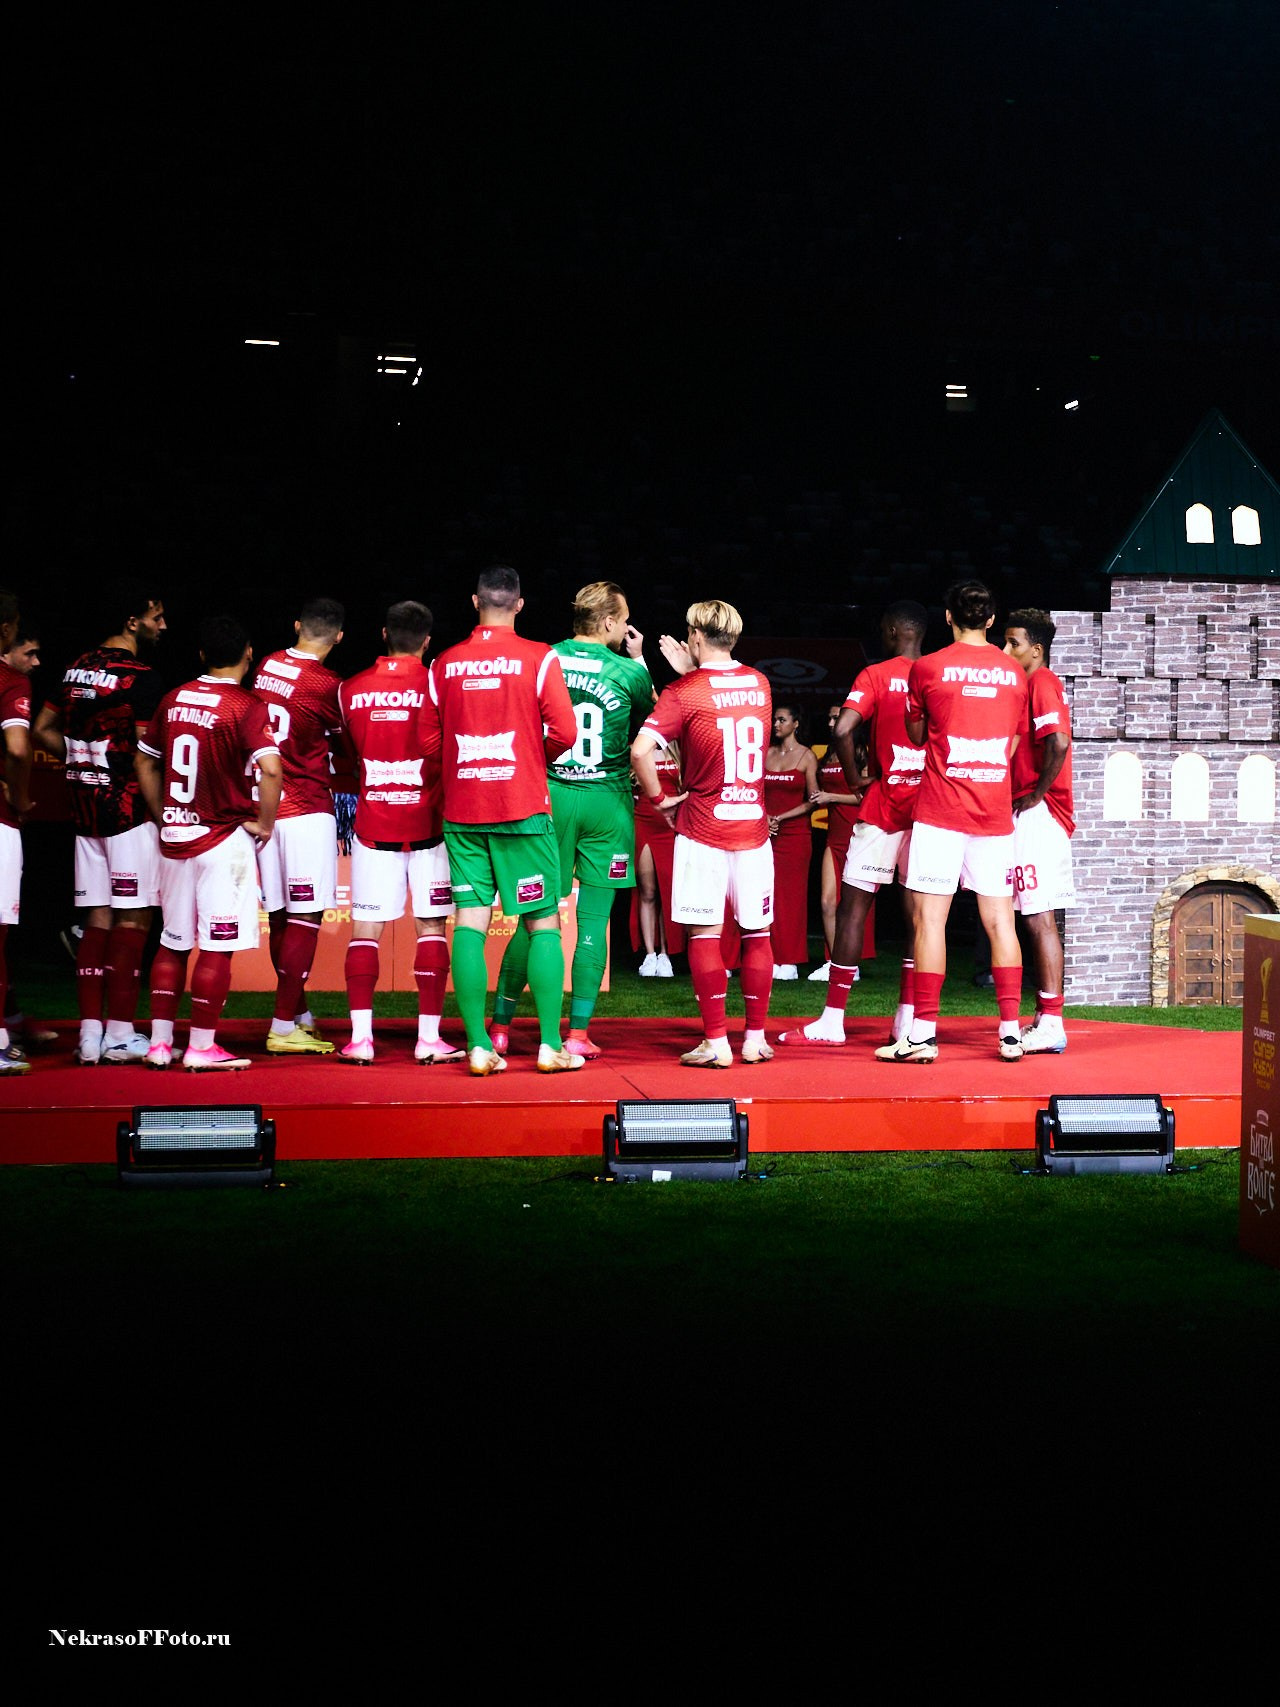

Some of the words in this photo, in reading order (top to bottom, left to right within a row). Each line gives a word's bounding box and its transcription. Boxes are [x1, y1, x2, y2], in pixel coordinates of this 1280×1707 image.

[445, 657, 522, 678] ЛУКОЙЛ
[942, 667, 1017, 686] ЛУКОЙЛ
[63, 668, 118, 690] ЛУКОЙЛ
[254, 674, 296, 698] ЗОБНИН
[711, 690, 766, 710] УМЯРОВ
[167, 706, 221, 730] УГАЛЬДЕ
[717, 716, 764, 784] 18
[169, 733, 200, 804] 9
[457, 766, 516, 781] GENESIS
[945, 767, 1007, 782] GENESIS
[366, 791, 421, 804] GENESIS
[1014, 864, 1038, 892] 83
